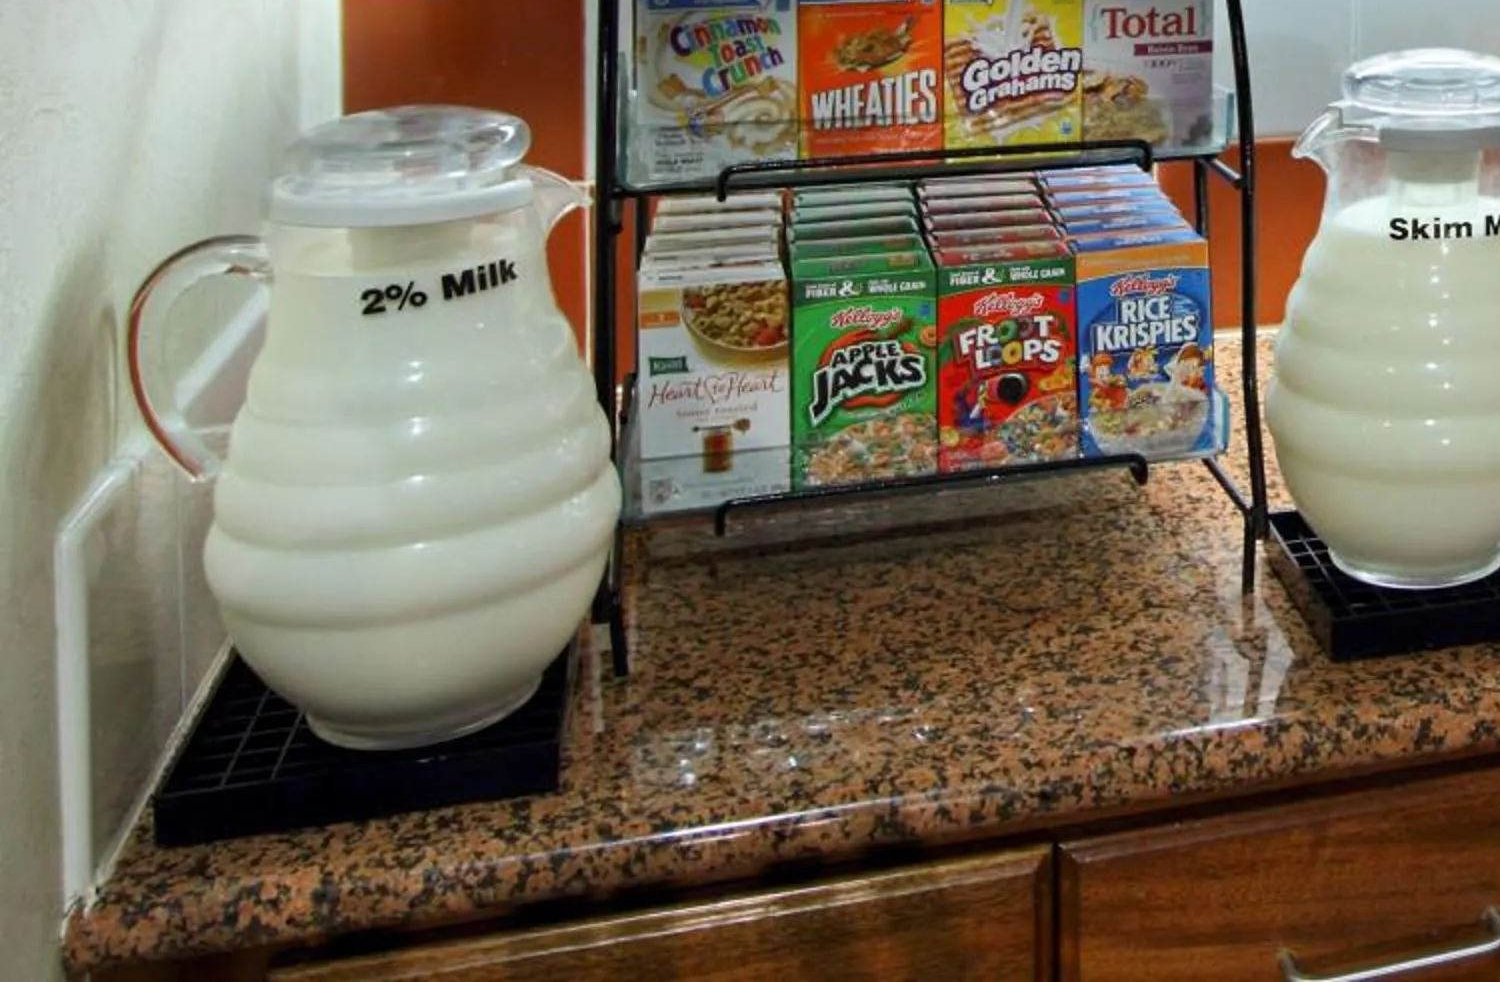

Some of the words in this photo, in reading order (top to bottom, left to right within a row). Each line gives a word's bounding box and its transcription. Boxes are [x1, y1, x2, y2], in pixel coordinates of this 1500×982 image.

[669, 16, 782, 57] Cinnamon
[1101, 6, 1196, 39] Total
[963, 48, 1081, 91] Golden
[811, 69, 937, 131] WHEATIES
[969, 73, 1076, 111] Grahams
[1389, 217, 1473, 240] Skim
[361, 281, 428, 315] 2%
[441, 259, 517, 300] Milk
[1120, 295, 1171, 323] RICE
[1096, 316, 1199, 350] KRISPIES
[832, 342, 899, 367] APPLE
[648, 376, 705, 408] Heart
[725, 371, 784, 401] Heart
[813, 356, 924, 417] JACKS
